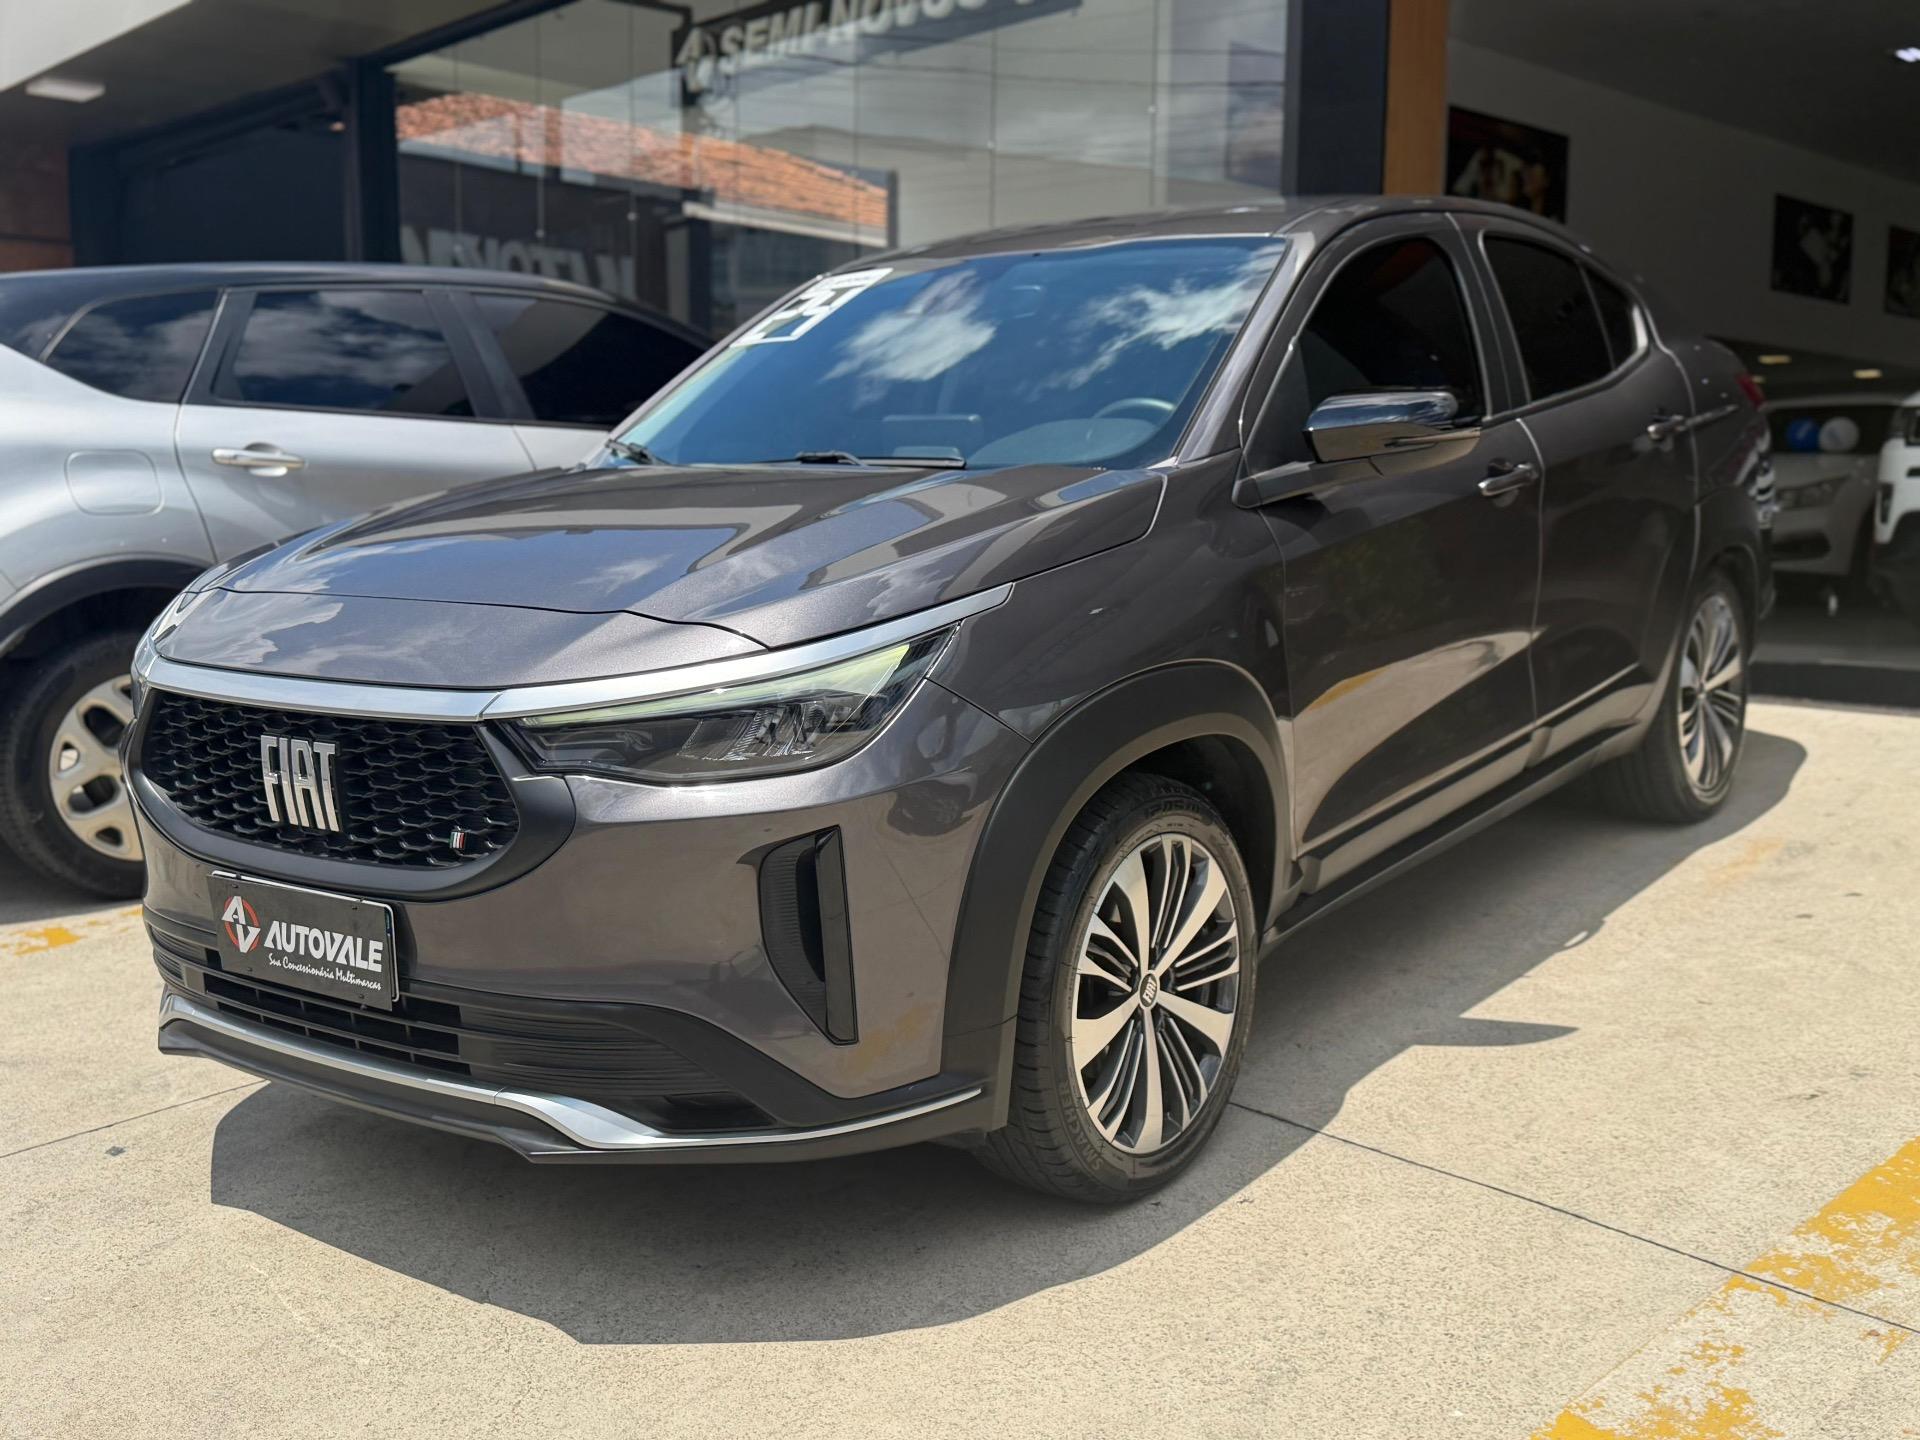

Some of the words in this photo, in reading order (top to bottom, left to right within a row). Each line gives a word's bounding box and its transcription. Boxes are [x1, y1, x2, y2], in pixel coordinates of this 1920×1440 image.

[719, 0, 992, 74] SEMI-NOV
[260, 734, 340, 832] FIAT
[263, 920, 383, 972] AUTOVALE
[268, 952, 282, 967] Sua
[282, 955, 334, 979] Concessionária
[335, 967, 382, 991] Multimarcas
[1142, 975, 1158, 1004] FIAT
[1058, 1079, 1105, 1171] SMACHER
